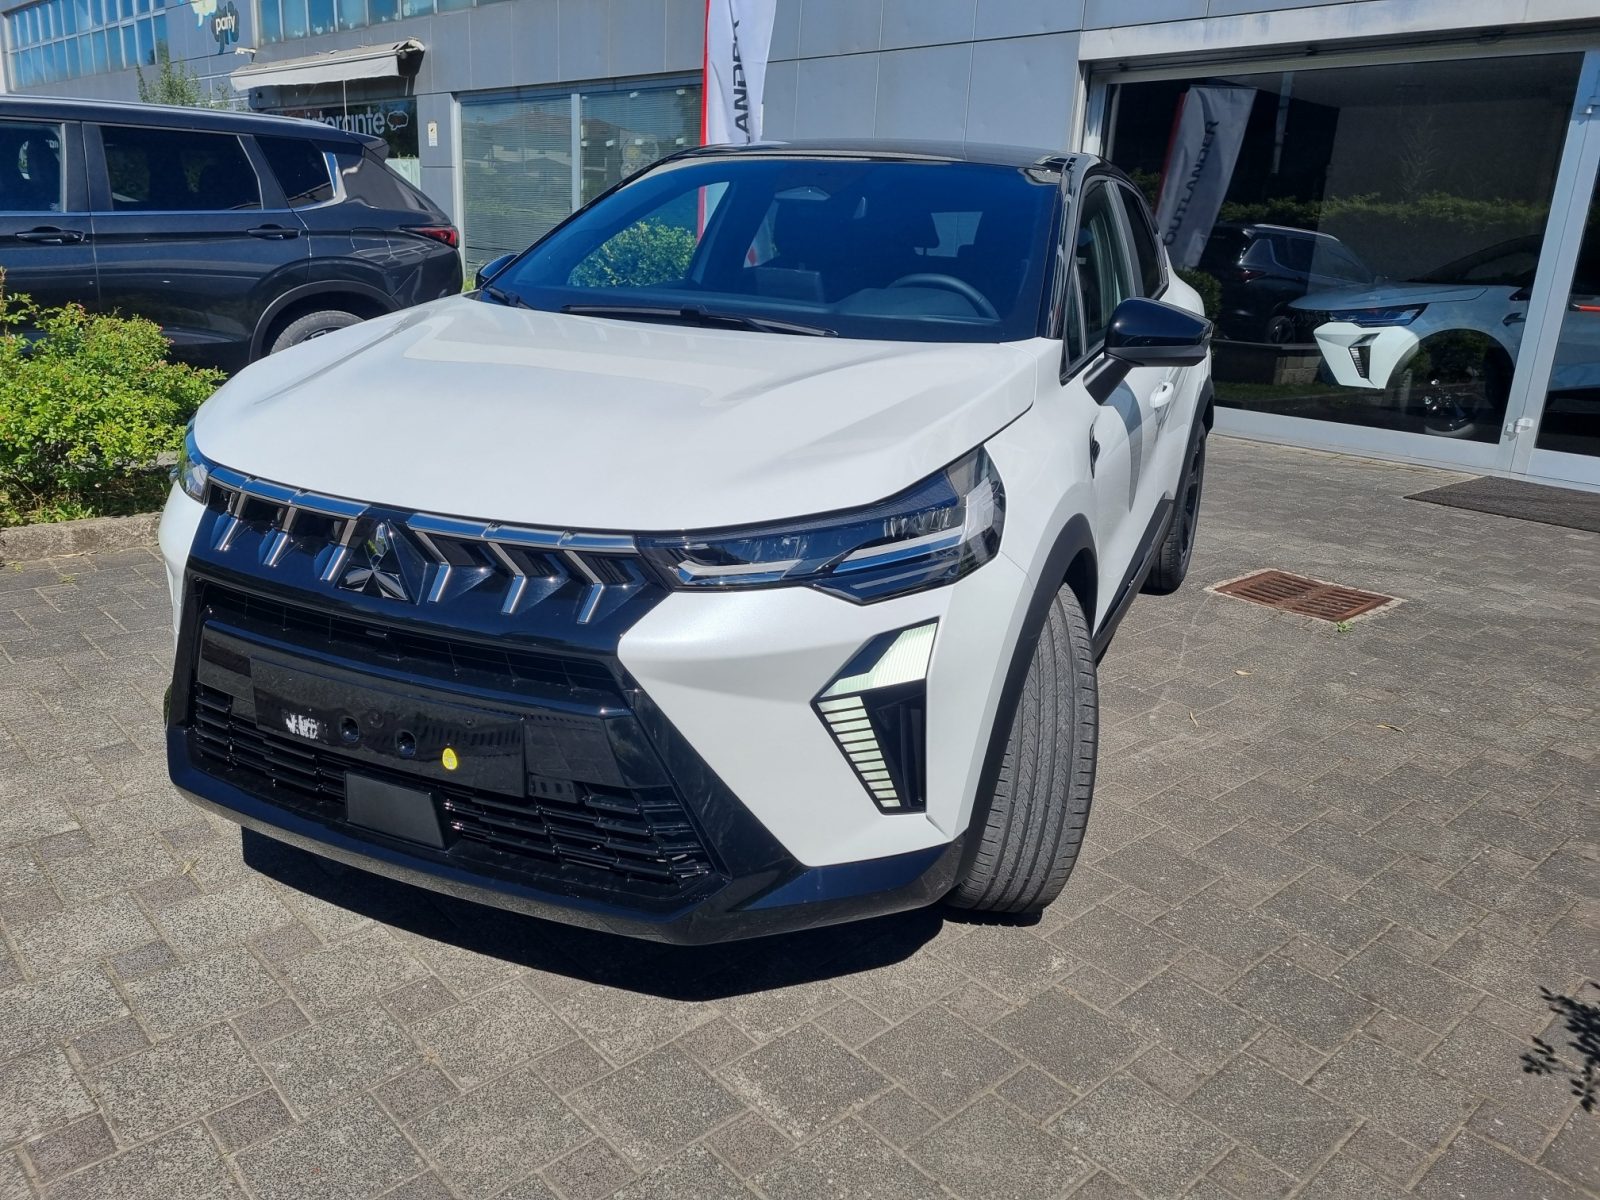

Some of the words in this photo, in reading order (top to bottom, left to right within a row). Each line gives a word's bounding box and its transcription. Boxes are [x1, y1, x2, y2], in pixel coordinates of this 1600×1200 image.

[215, 12, 235, 35] party
[304, 106, 385, 134] torante
[1165, 120, 1219, 245] OUTLANDER
